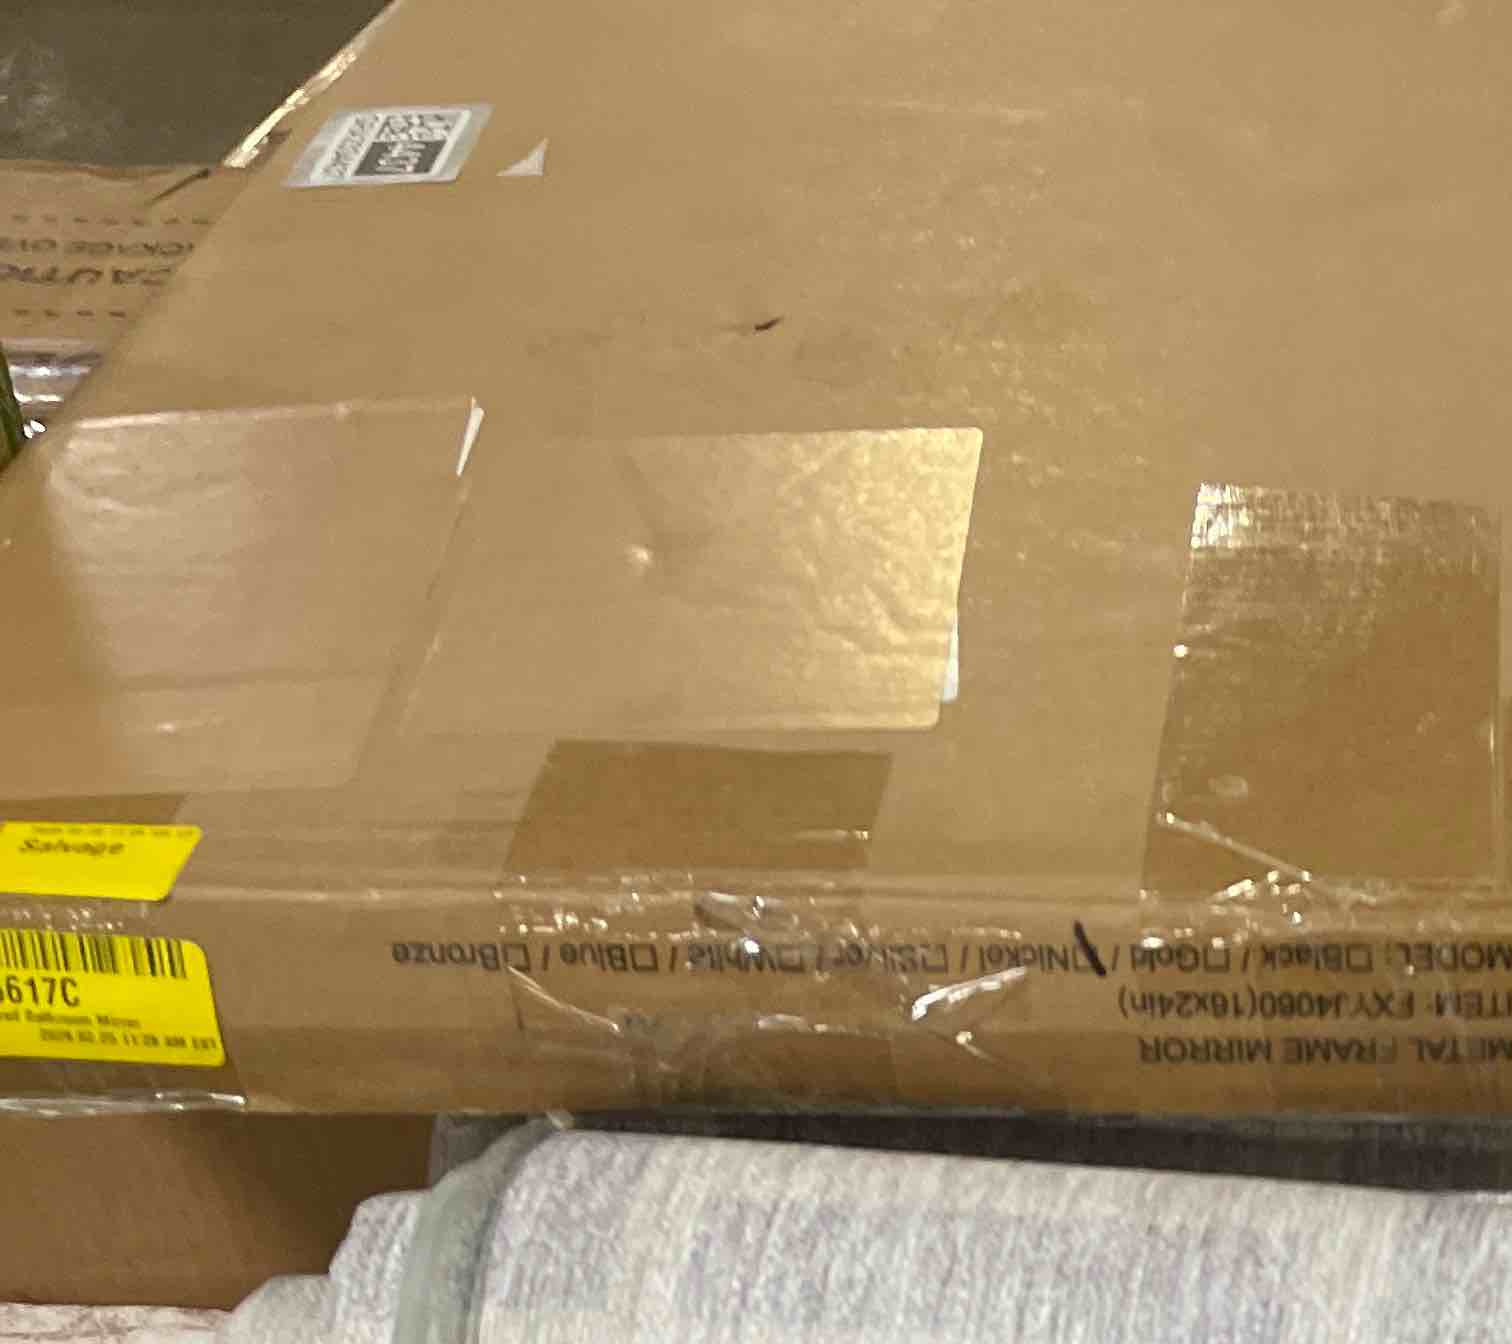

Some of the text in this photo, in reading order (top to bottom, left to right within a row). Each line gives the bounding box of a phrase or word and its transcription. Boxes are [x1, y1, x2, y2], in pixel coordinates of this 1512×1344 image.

[0, 975, 80, 1008] 617C
[1136, 1036, 1512, 1063] METAL FRAME MIRROR
